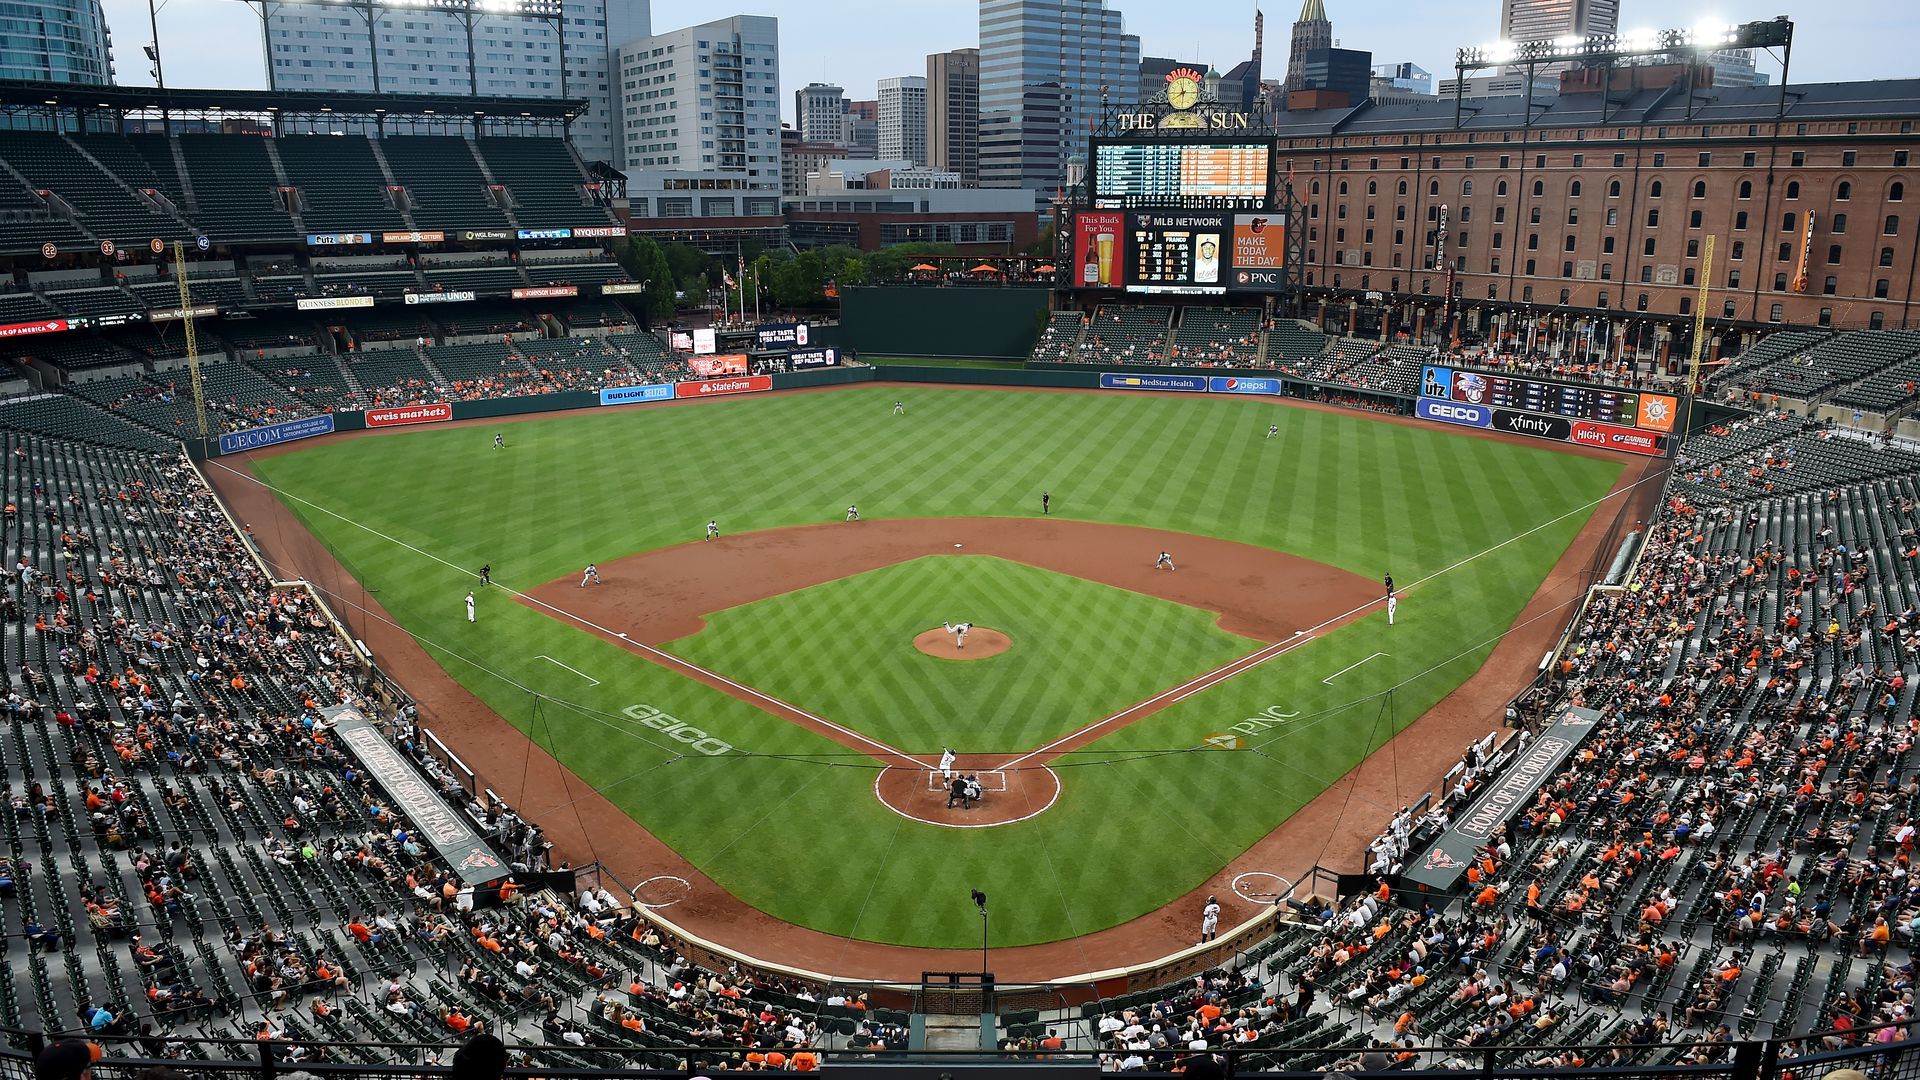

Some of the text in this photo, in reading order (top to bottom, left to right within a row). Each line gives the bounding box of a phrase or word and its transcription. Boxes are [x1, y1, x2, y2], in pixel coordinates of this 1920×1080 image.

[1166, 68, 1202, 82] ORIOLES
[1118, 113, 1248, 129] THE SUN
[1227, 200, 1234, 209] 3
[1243, 200, 1248, 209] 1
[1256, 200, 1264, 209] 0
[1154, 218, 1222, 226] MLB NETWORK
[155, 242, 160, 250] 8
[1238, 237, 1265, 246] MAKE
[45, 246, 55, 255] 22
[103, 244, 112, 252] 33
[1237, 247, 1267, 255] TODAY
[1237, 256, 1255, 265] THE
[1251, 273, 1277, 284] PNC
[447, 291, 473, 299] UNION
[299, 300, 335, 308] GUINNESS
[18, 326, 46, 334] AMERICA
[1240, 382, 1267, 391] pepsi
[1426, 383, 1446, 397] utz
[608, 392, 623, 400] BUD
[644, 388, 667, 397] SELTZER
[372, 408, 446, 422] weis markets
[1428, 404, 1479, 422] GEICO
[1509, 414, 1552, 435] xfinity
[283, 430, 309, 438] OSTEOPATHIC
[1577, 430, 1606, 444] HIGH'S
[1624, 435, 1652, 445] CARROLL
[1228, 705, 1300, 736] PNC
[622, 704, 733, 756] GEICO
[1464, 740, 1564, 834] HOME OF THE ORIOLES
[384, 764, 408, 782] TO
[396, 781, 439, 820] ORIOLE
[427, 812, 463, 842] PARK
[1165, 1005, 1174, 1014] 31
